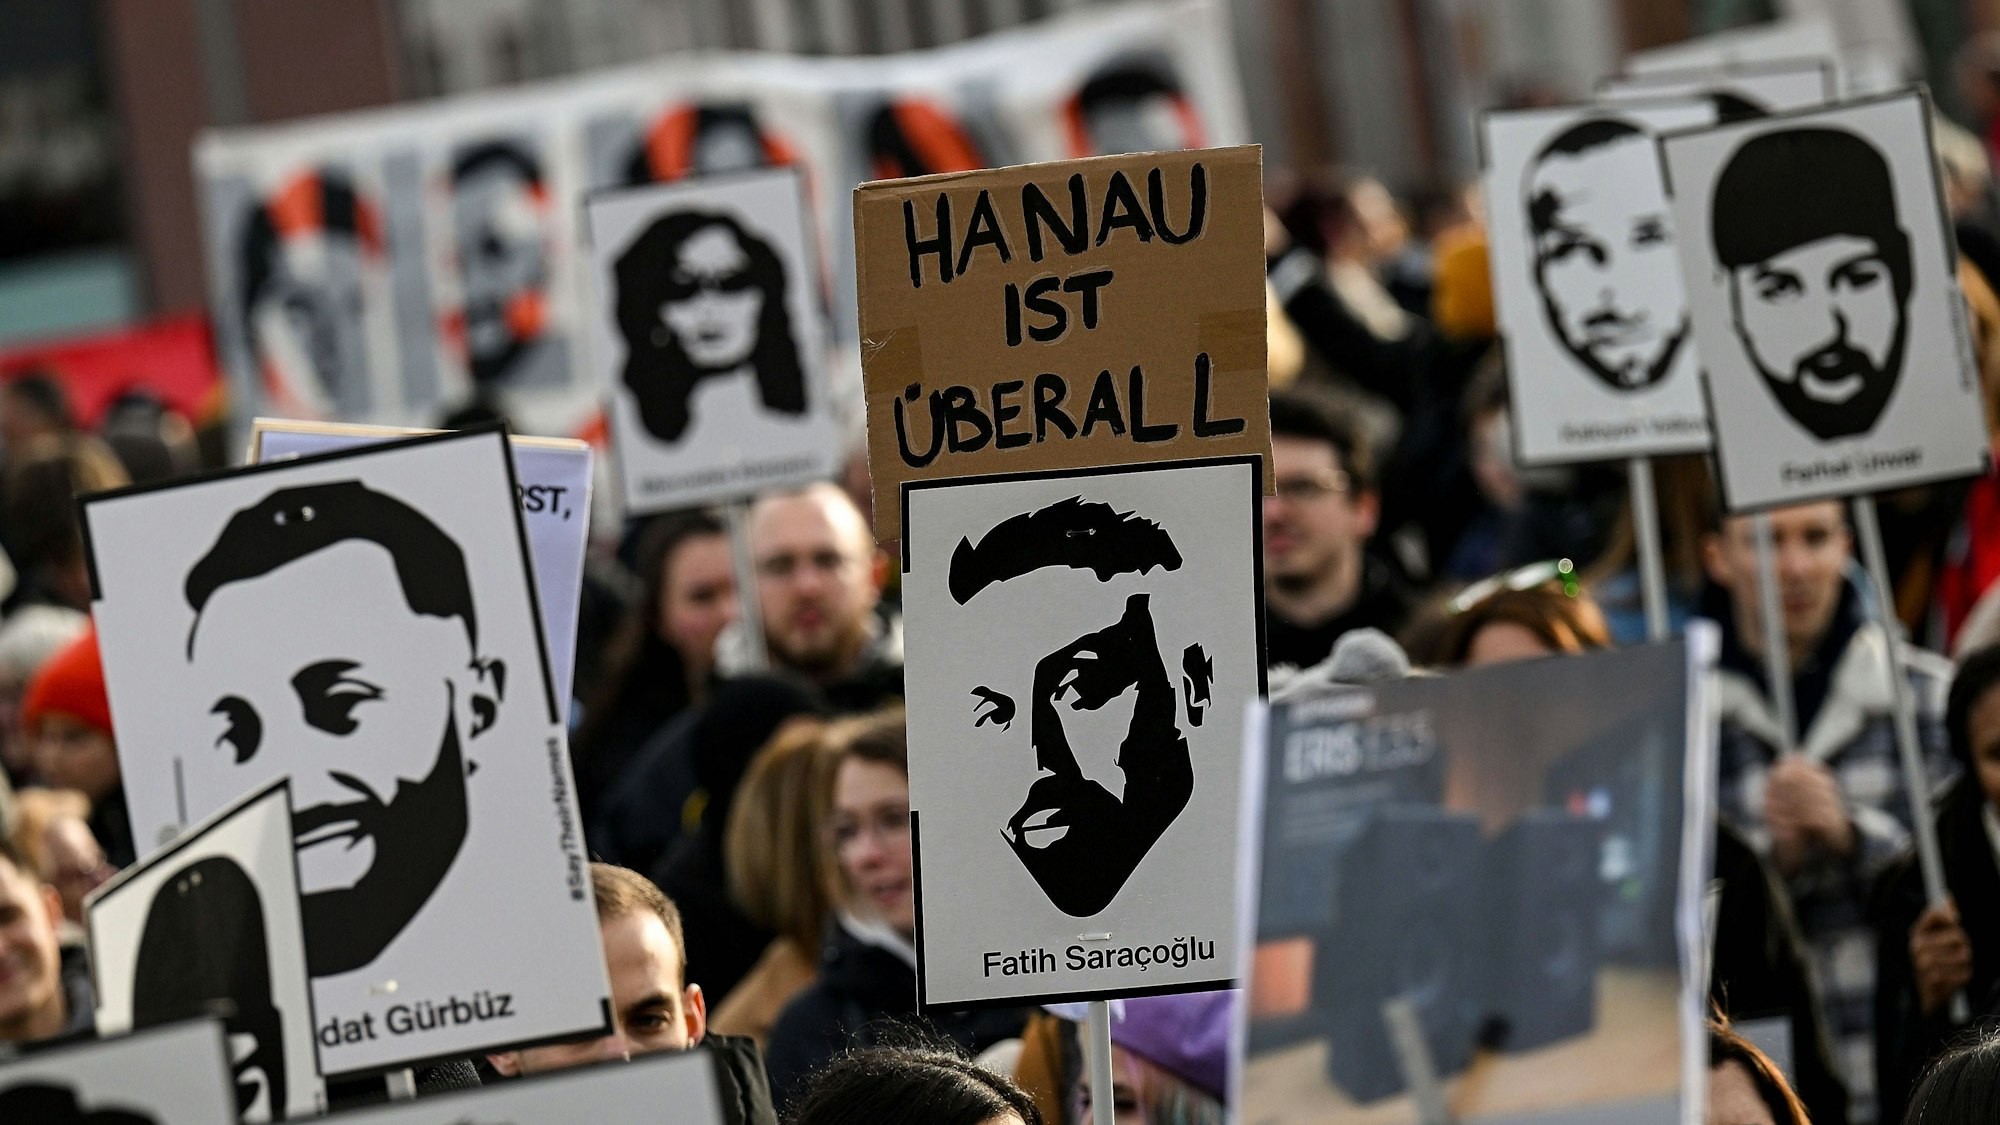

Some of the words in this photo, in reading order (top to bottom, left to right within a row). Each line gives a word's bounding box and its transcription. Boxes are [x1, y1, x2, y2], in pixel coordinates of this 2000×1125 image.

[902, 163, 1207, 289] HANAU
[1004, 270, 1115, 347] IST
[894, 352, 1246, 468] ÜBERALL
[547, 737, 584, 900] #SayTheirNames
[983, 947, 1056, 978] Fatih
[1064, 936, 1216, 972] Saraçoğlu
[319, 1017, 377, 1048] dat
[386, 990, 516, 1035] Gürbüz
